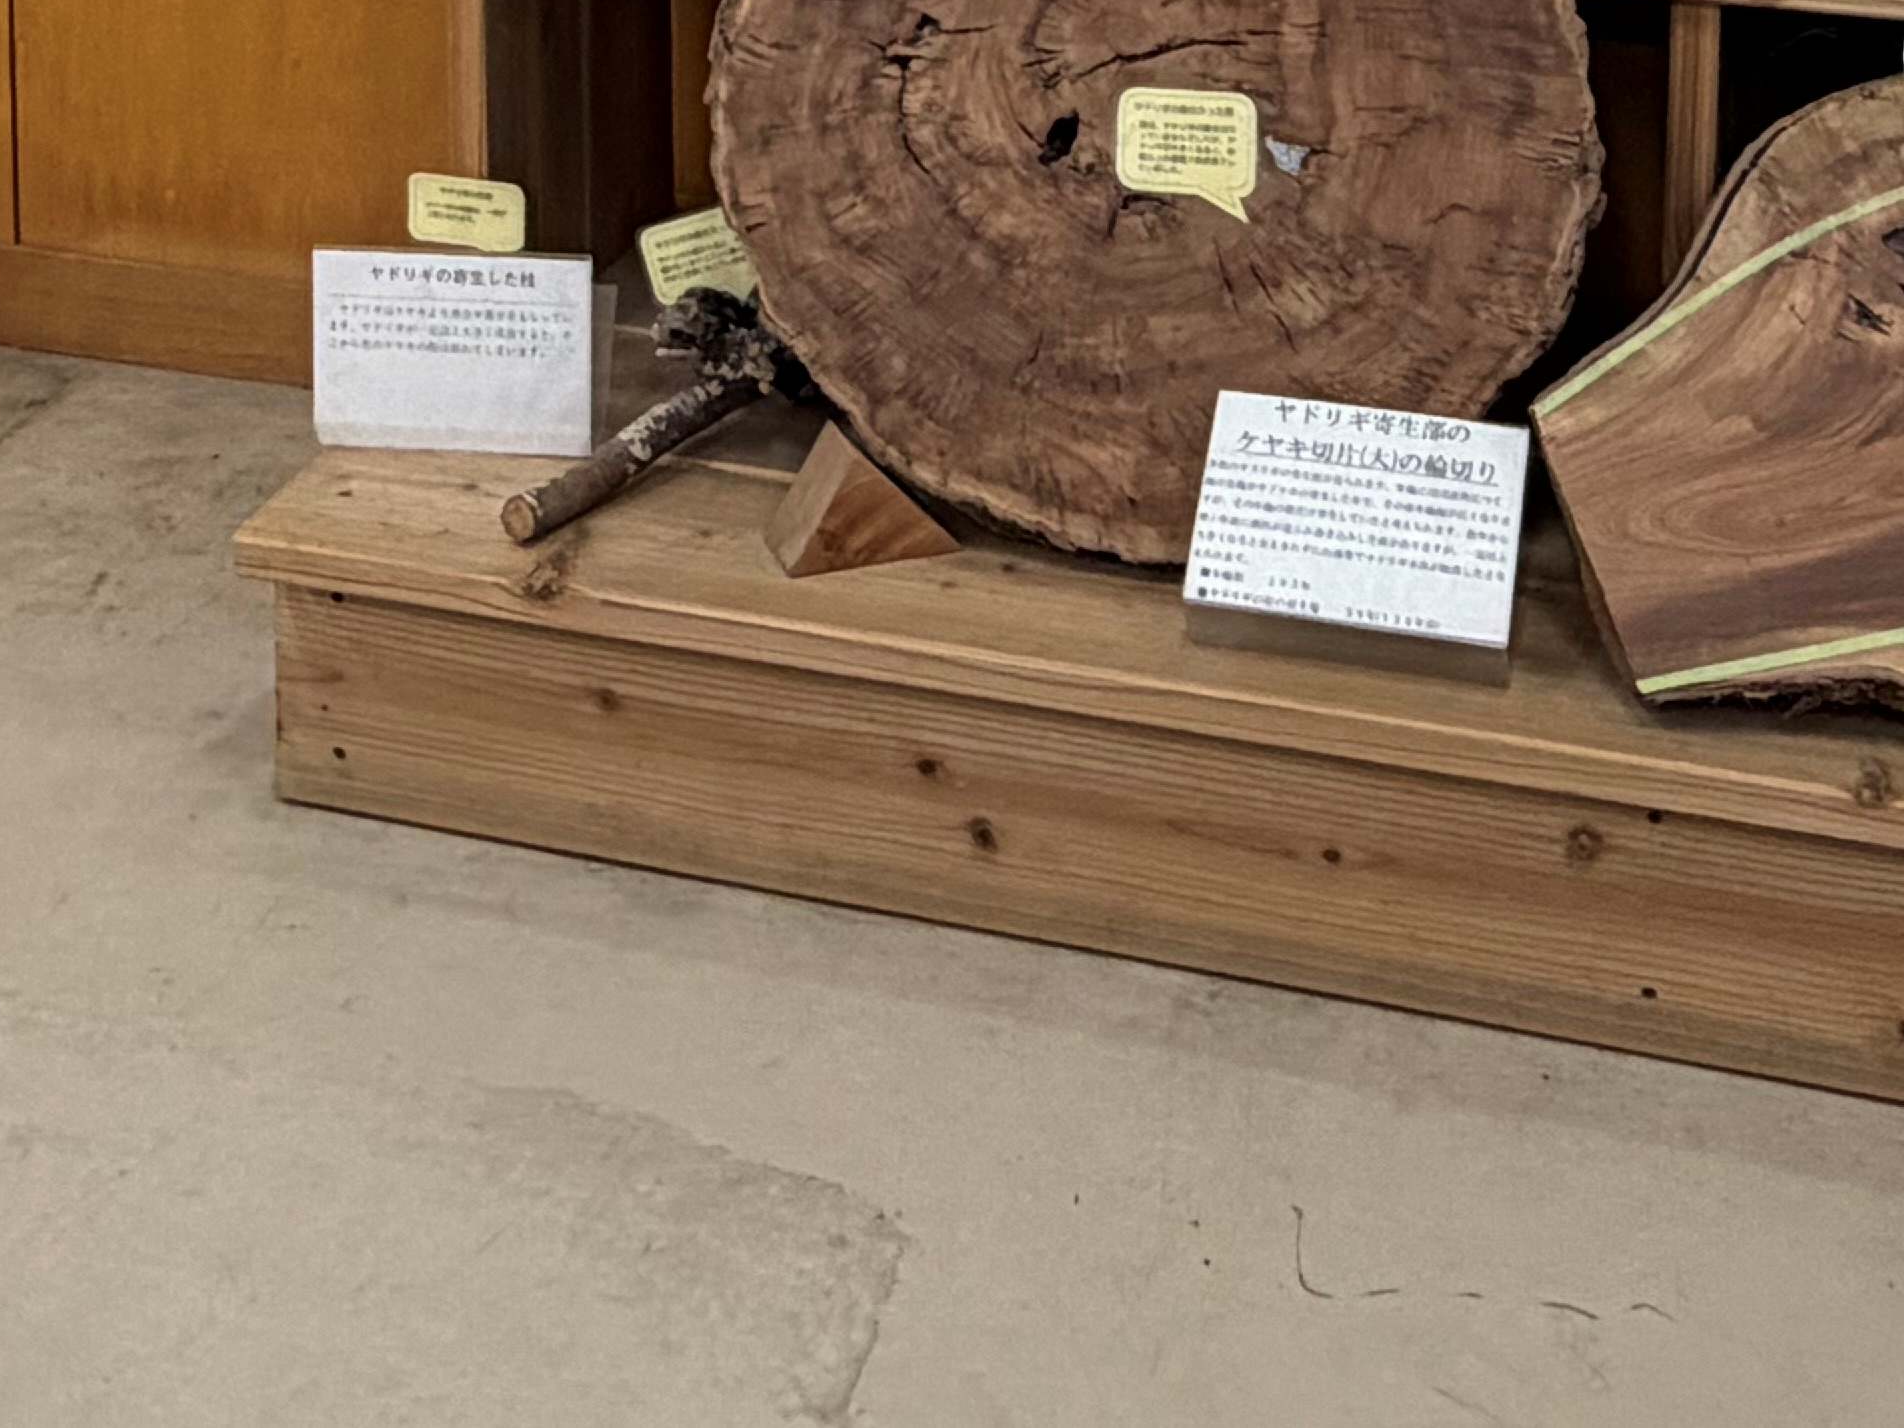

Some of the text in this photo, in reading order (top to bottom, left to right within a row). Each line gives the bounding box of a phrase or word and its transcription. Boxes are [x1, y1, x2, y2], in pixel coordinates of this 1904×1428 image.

[371, 266, 536, 289] ヤドリギの寄生した枝
[1274, 399, 1471, 443] ヤドリギ寄生部の
